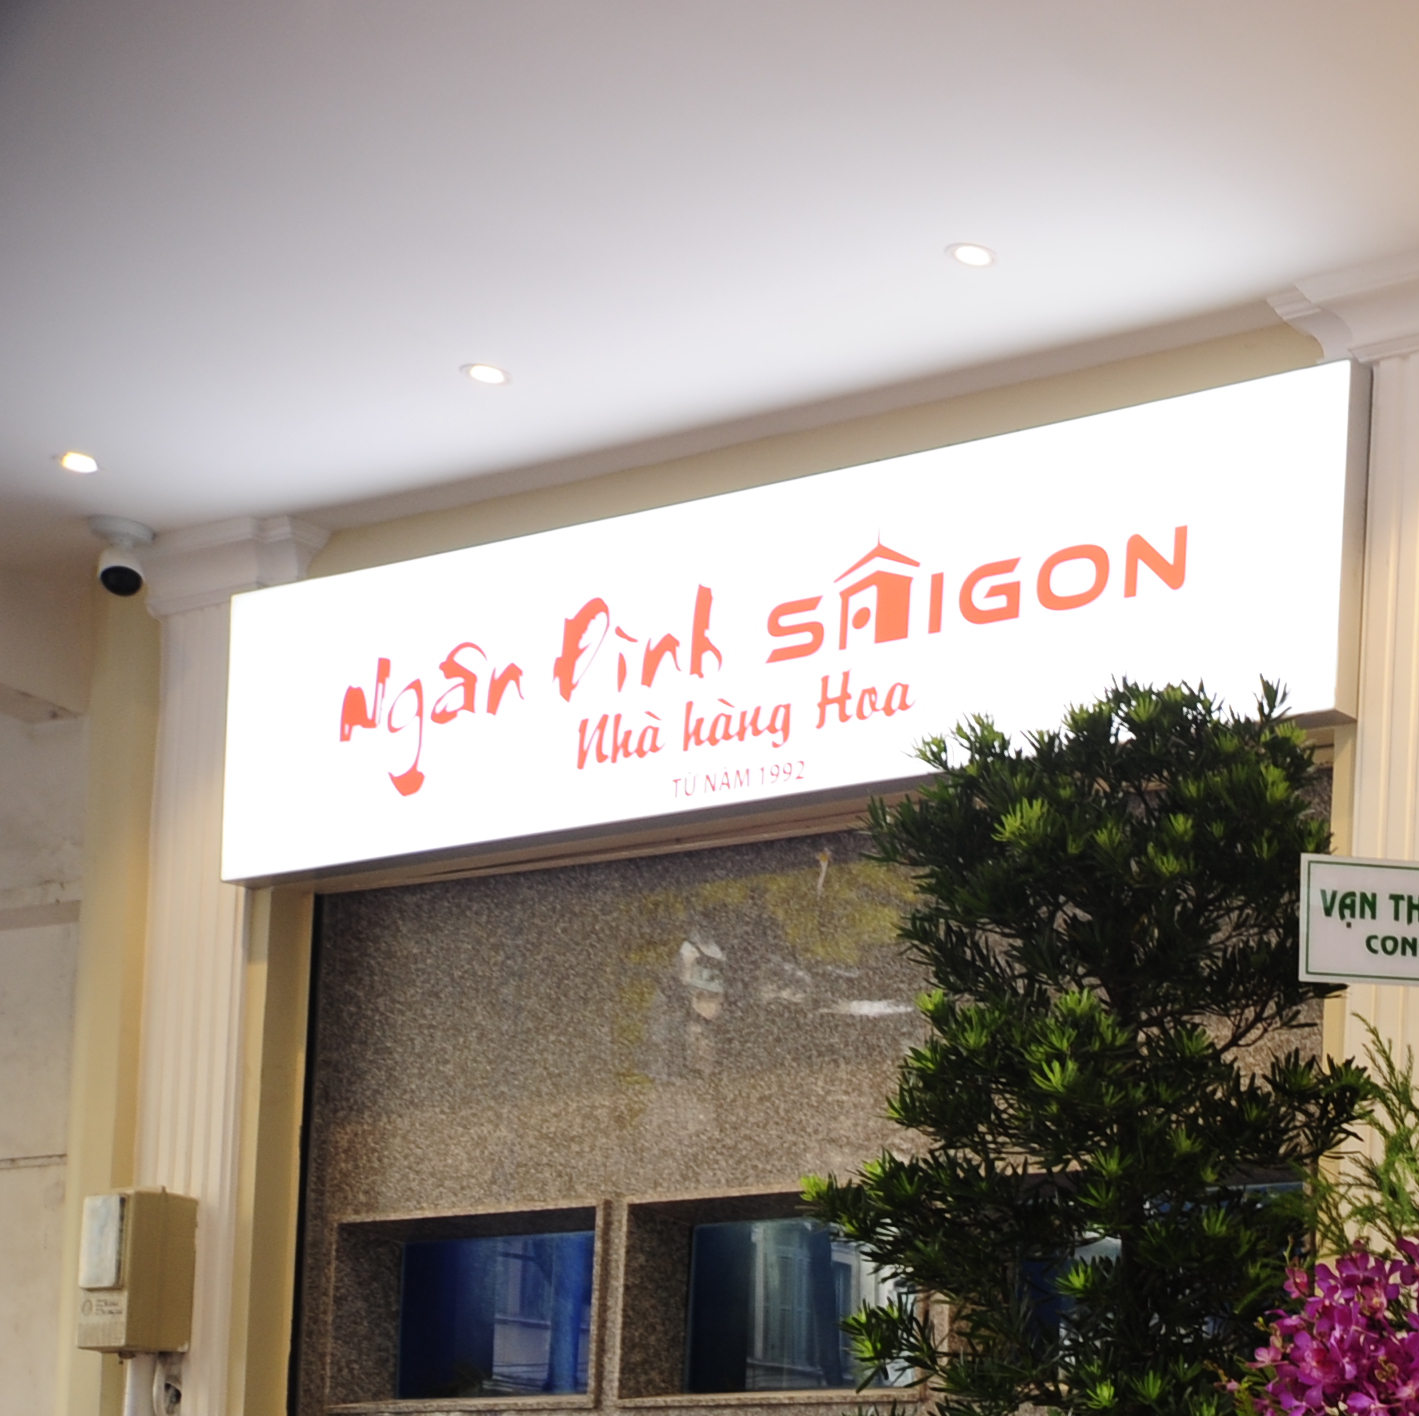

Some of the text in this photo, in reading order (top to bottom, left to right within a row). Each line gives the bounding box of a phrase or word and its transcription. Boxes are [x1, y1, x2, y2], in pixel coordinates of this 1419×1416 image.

[340, 640, 525, 797] Ngân
[576, 669, 915, 770] Nhà hàng Hoa
[759, 760, 806, 785] 1992
[1318, 888, 1378, 930] VẠN
